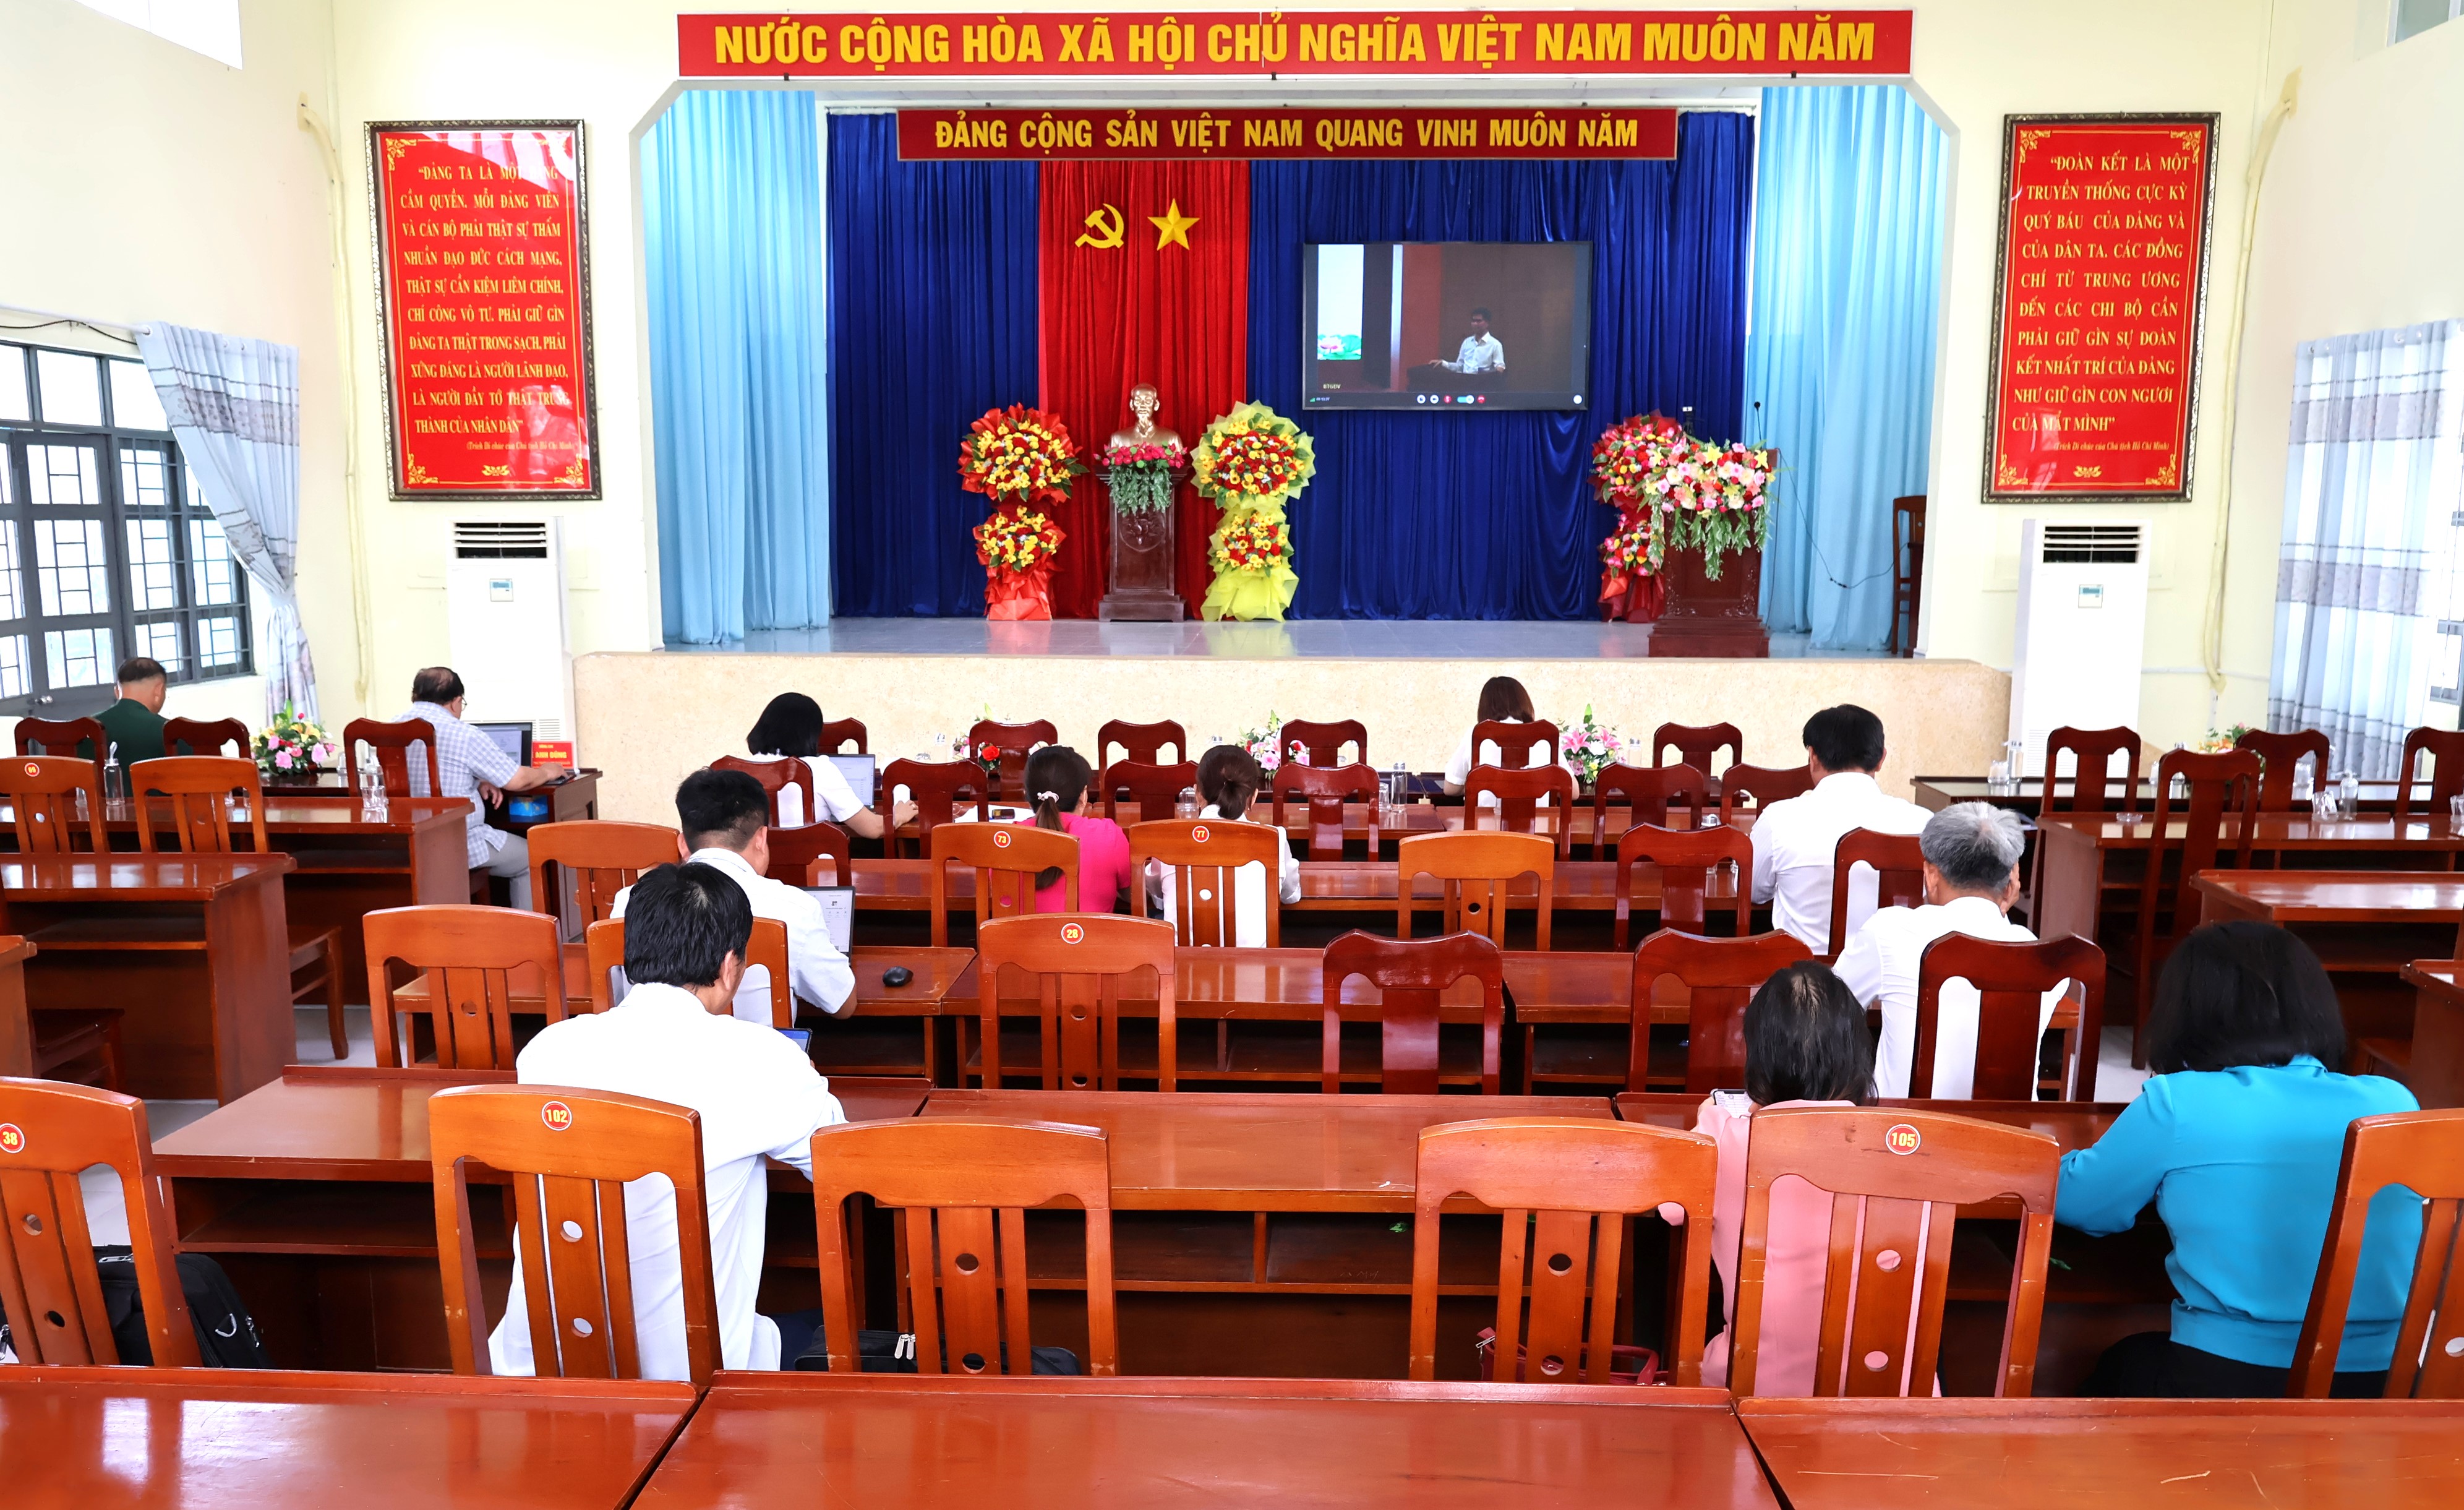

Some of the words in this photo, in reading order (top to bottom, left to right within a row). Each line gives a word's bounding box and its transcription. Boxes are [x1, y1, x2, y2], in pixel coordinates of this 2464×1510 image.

[716, 16, 827, 64] NƯỚC
[840, 18, 949, 71] CỘNG
[963, 16, 1043, 62] HÒA
[1058, 18, 1114, 62] XÃ
[1129, 16, 1194, 71] HỘI
[1208, 12, 1287, 62] CHỦ
[1299, 16, 1426, 62] NGHĨA
[1437, 15, 1522, 69] VIỆT
[1536, 23, 1632, 62] NAM
[1644, 14, 1766, 62] MUÔN
[1779, 14, 1874, 62] NĂM
[935, 109, 1006, 148] ĐẢNG
[1020, 112, 1092, 154] CỘNG
[1106, 109, 1157, 148] SẢN
[1171, 113, 1231, 153] VIỆT
[1244, 119, 1302, 147] NAM
[1316, 119, 1402, 152] QUANG
[1417, 119, 1476, 147] VINH
[1490, 111, 1566, 147] MUÔN
[1578, 113, 1637, 147] NĂM
[2101, 150, 2128, 171] KẾT
[2135, 152, 2152, 171] LÀ
[2160, 152, 2190, 174] MỘT
[2027, 178, 2079, 200] TRUYỀN
[2085, 179, 2131, 200] THỐNG
[2136, 184, 2164, 204] CỰC
[2169, 181, 2188, 200] KỲ
[2024, 210, 2051, 232] QUÝ
[2057, 211, 2084, 229] BÁU
[2094, 210, 2120, 229] CỦA
[2126, 210, 2162, 229] ĐẢNG
[2168, 210, 2185, 229] VÀ
[2022, 239, 2048, 258] CỦA
[2055, 240, 2082, 258] DÂN
[2113, 239, 2142, 258] CÁC
[2146, 236, 2183, 258] ĐỒNG
[2021, 268, 2047, 288] CHÍ
[2056, 269, 2075, 288] TỪ
[2084, 273, 2131, 288] TRUNG
[2142, 271, 2180, 288] ƯƠNG
[2020, 296, 2045, 317] ĐẾN
[2055, 298, 2082, 317] CÁC
[2091, 302, 2115, 317] CHI
[2124, 298, 2142, 320] BỘ
[2151, 295, 2178, 317] CẦN
[2018, 327, 2048, 346] PHẢI
[2056, 328, 2080, 346] GIỮ
[2086, 327, 2110, 346] GÌN
[2116, 329, 2134, 350] SỰ
[2140, 327, 2176, 346] ĐOÀN
[2016, 354, 2043, 374] KẾT
[2045, 354, 2081, 374] NHẤT
[2084, 356, 2106, 374] TRÍ
[2108, 356, 2135, 374] CỦA
[2139, 356, 2175, 374] ĐẢNG
[2014, 387, 2042, 403] NHƯ
[2045, 385, 2069, 403] GIỮ
[2072, 385, 2096, 403] GÌN
[2100, 388, 2128, 403] CON
[2012, 413, 2038, 431] CỦA
[2042, 410, 2071, 431] MẮT
[998, 835, 1007, 844] 73
[1196, 830, 1205, 838] 77
[1066, 929, 1079, 938] 28
[545, 1109, 568, 1123] 102
[2, 1131, 18, 1146] 38
[1891, 1132, 1915, 1148] 105
